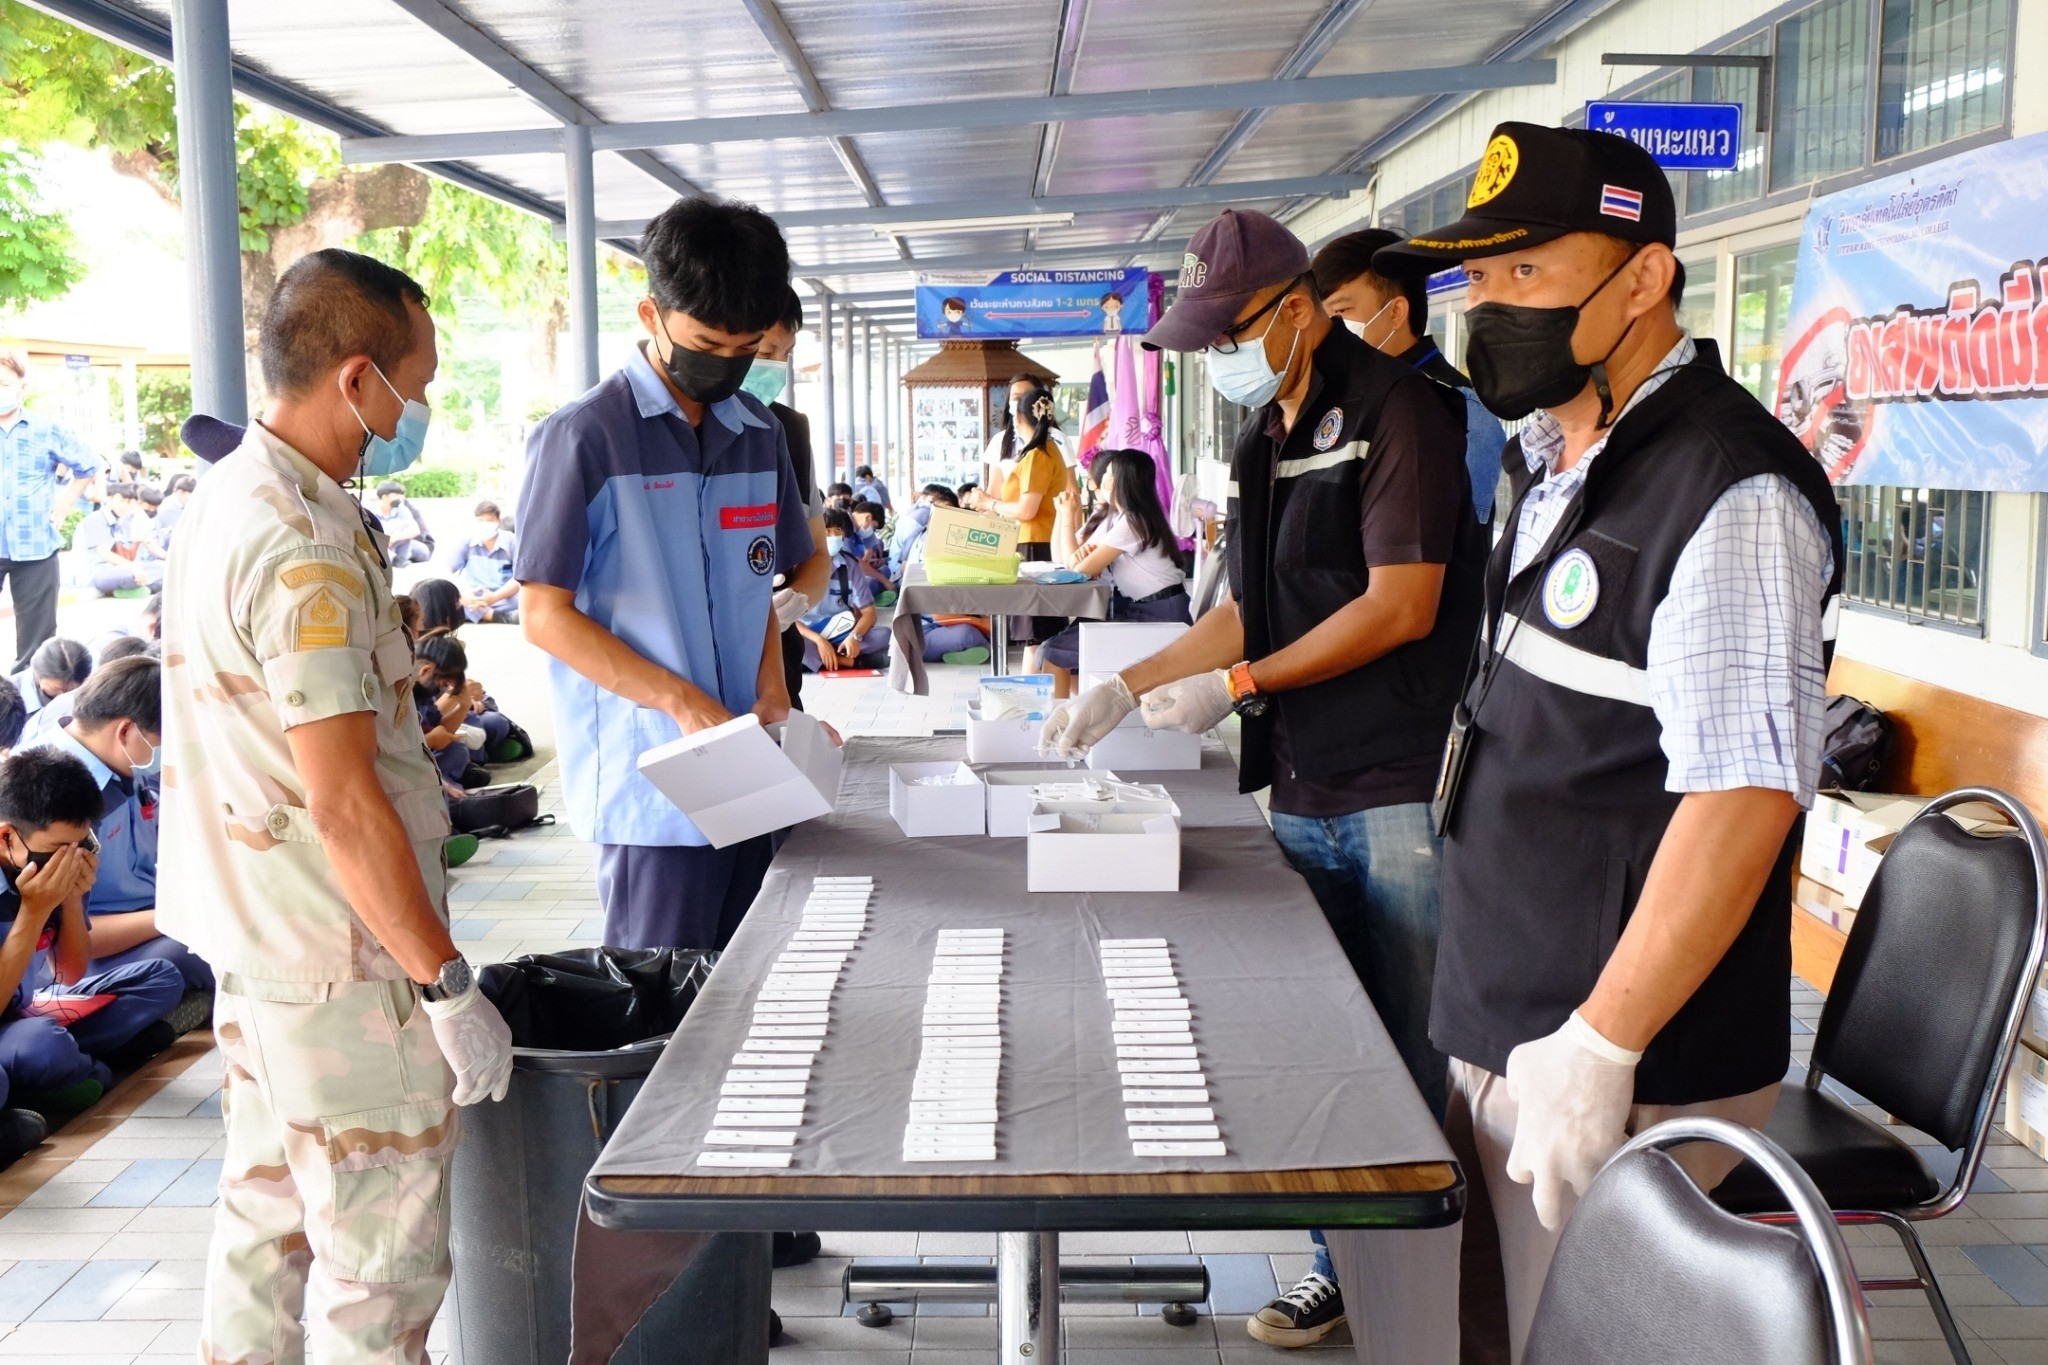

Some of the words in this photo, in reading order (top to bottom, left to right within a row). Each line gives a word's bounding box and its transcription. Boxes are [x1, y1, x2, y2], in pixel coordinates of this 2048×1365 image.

[1921, 221, 1950, 235] COLLEGE
[1010, 272, 1052, 283] SOCIAL
[1055, 270, 1125, 282] DISTANCING
[1056, 297, 1073, 307] 1-2
[969, 530, 998, 545] GPO
